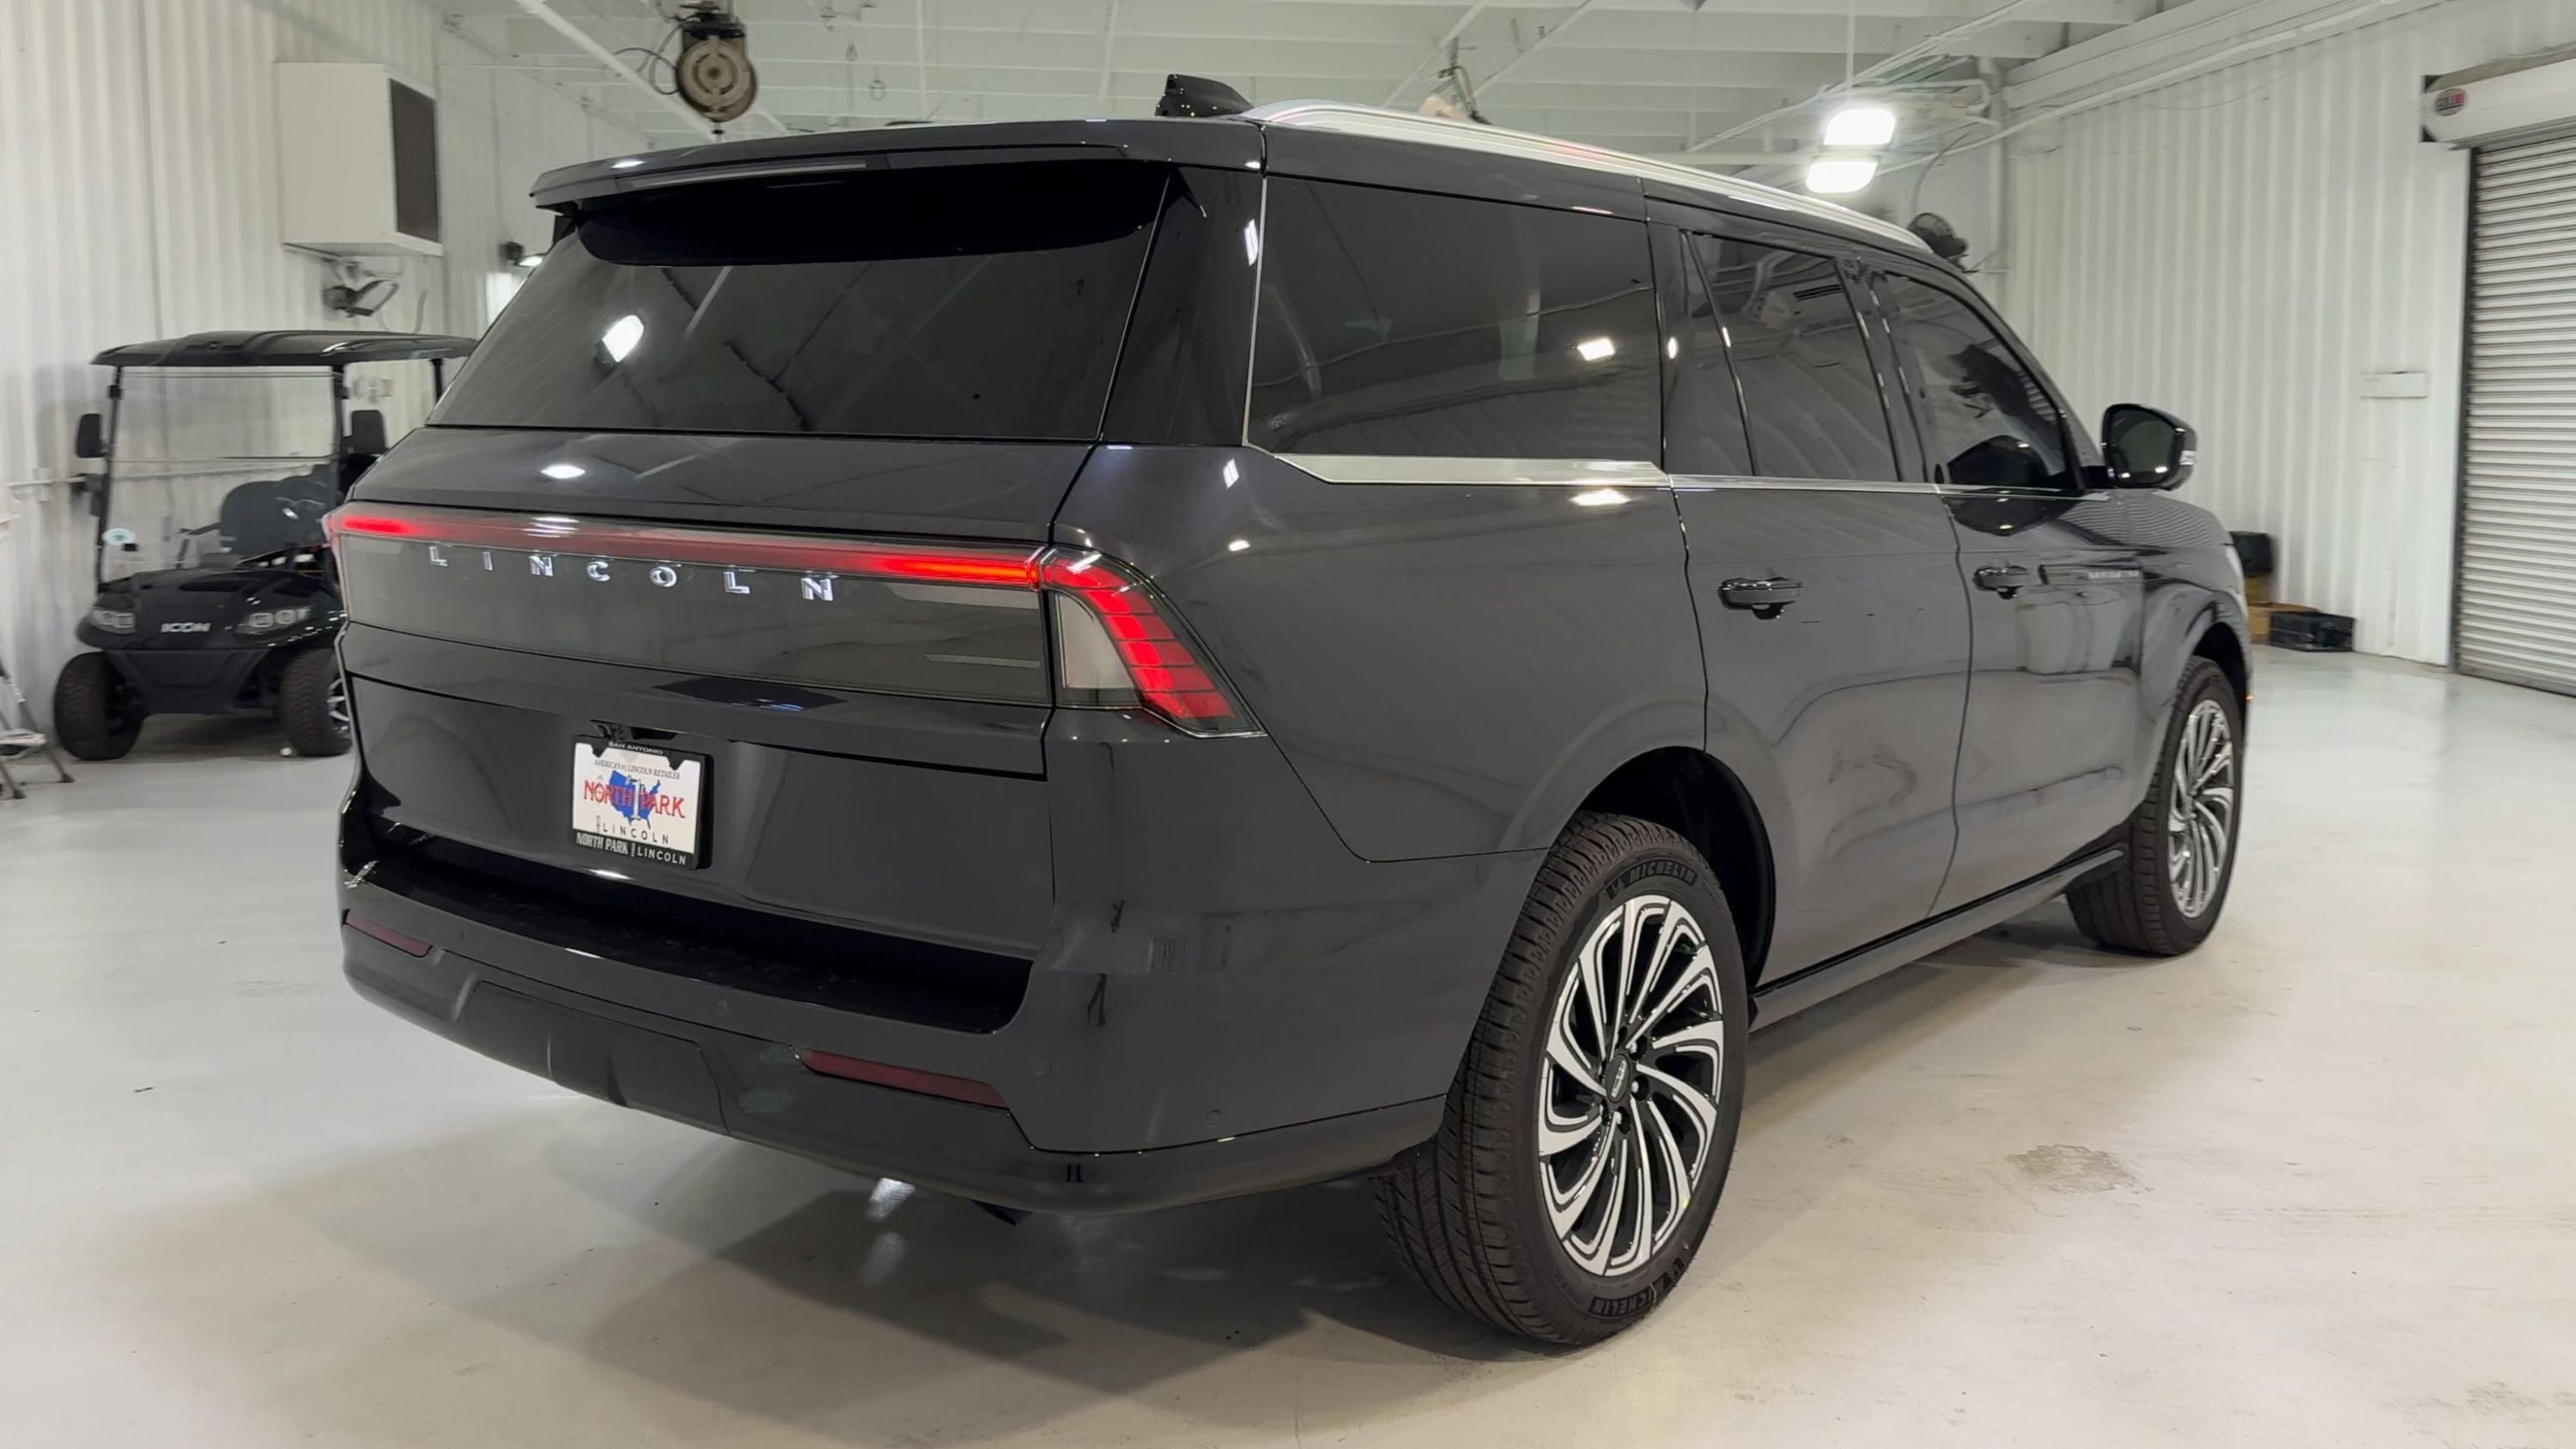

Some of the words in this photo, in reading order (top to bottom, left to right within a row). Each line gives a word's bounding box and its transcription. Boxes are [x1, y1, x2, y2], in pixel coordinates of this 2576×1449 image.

[429, 545, 834, 602] LINCOLN
[161, 622, 211, 633] ICON
[627, 744, 664, 755] ANTONIO
[628, 765, 653, 775] LINCOLN
[653, 769, 681, 779] RETAILER
[584, 780, 634, 808] NORTH
[641, 791, 686, 819] PARK
[603, 822, 669, 846] LINCOLN
[576, 833, 604, 850] NORTH
[605, 838, 629, 855] PARK
[637, 846, 686, 866] LINCOLN
[1629, 860, 1698, 885] MICHELIN
